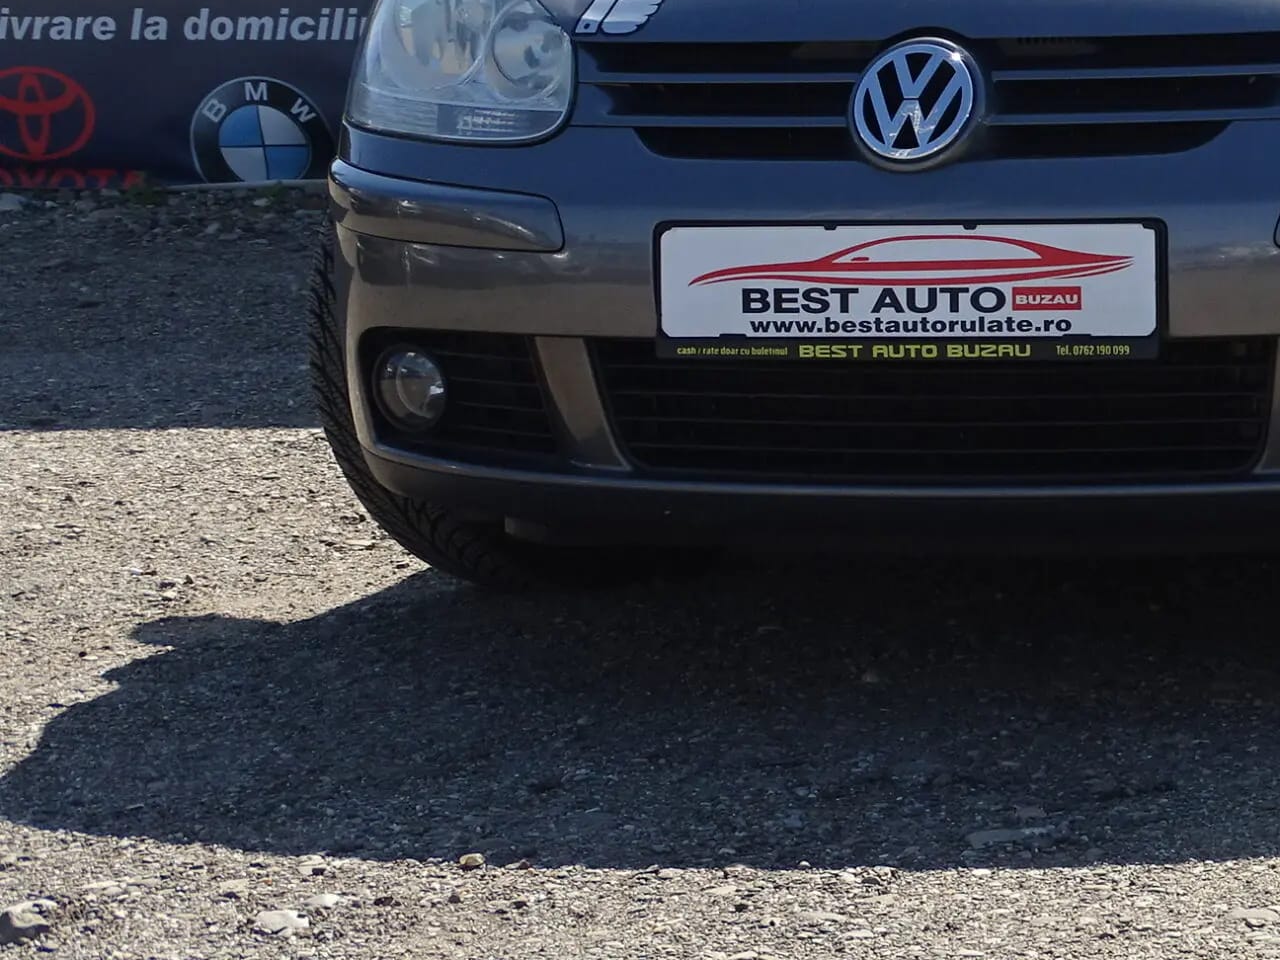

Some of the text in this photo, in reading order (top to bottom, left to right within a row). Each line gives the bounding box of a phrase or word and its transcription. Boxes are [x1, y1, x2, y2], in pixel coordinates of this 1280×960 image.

[131, 8, 168, 40] la
[201, 81, 318, 124] BMW
[741, 286, 1079, 314] BEST AUTO BUZAU
[750, 316, 1073, 334] www.bestautorulate.ro
[677, 346, 697, 355] cash
[703, 346, 719, 355] rate
[741, 347, 751, 355] cu
[799, 344, 1031, 358] BEST AUTO BUZAU
[1056, 345, 1072, 355] Tel.
